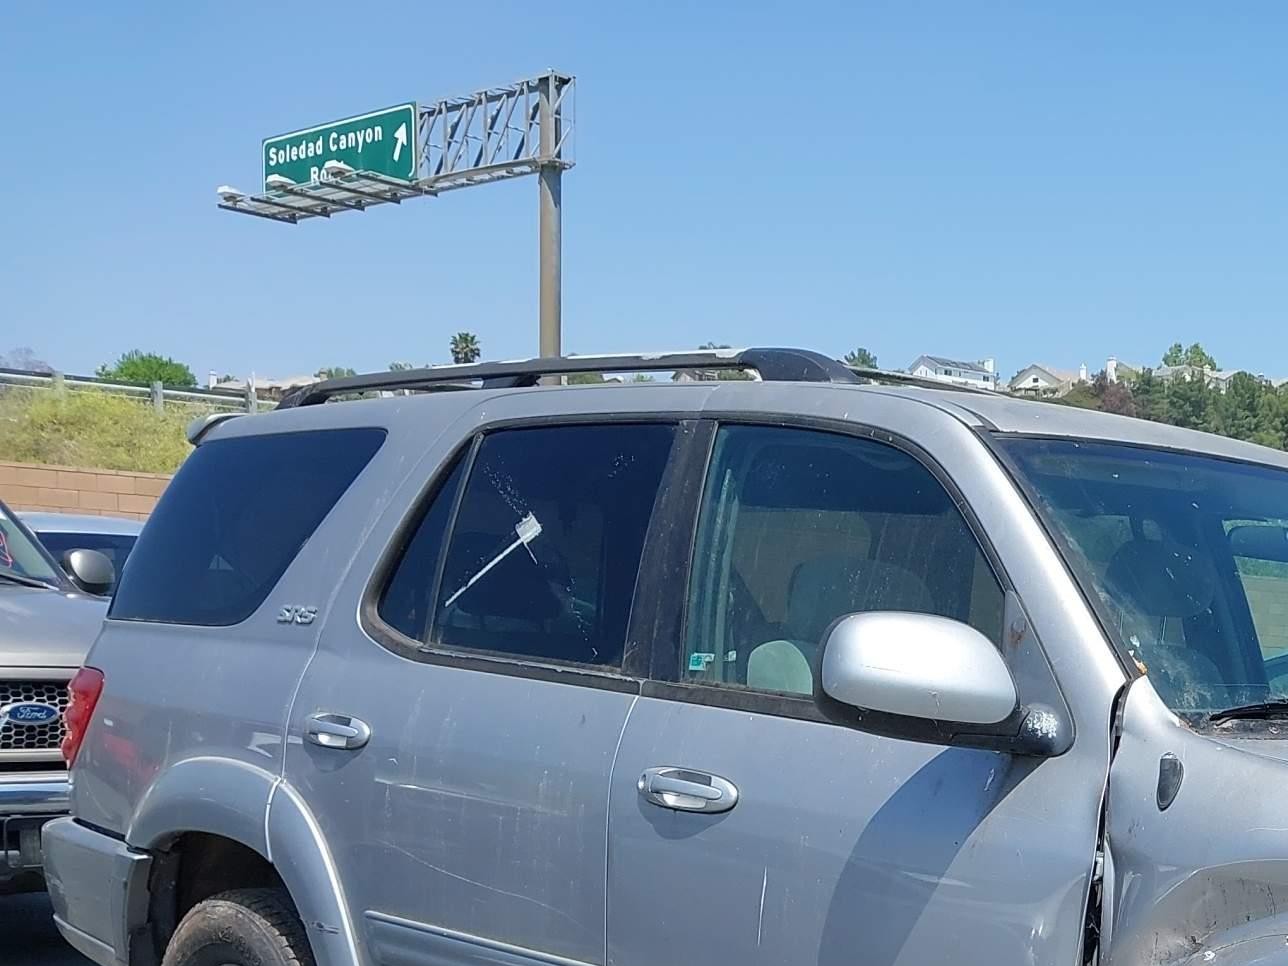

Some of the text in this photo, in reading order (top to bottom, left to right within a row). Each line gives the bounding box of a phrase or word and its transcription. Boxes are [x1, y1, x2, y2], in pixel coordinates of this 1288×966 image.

[268, 125, 383, 167] Soledad Canyon
[310, 166, 334, 183] Ro
[17, 706, 48, 719] Ford
